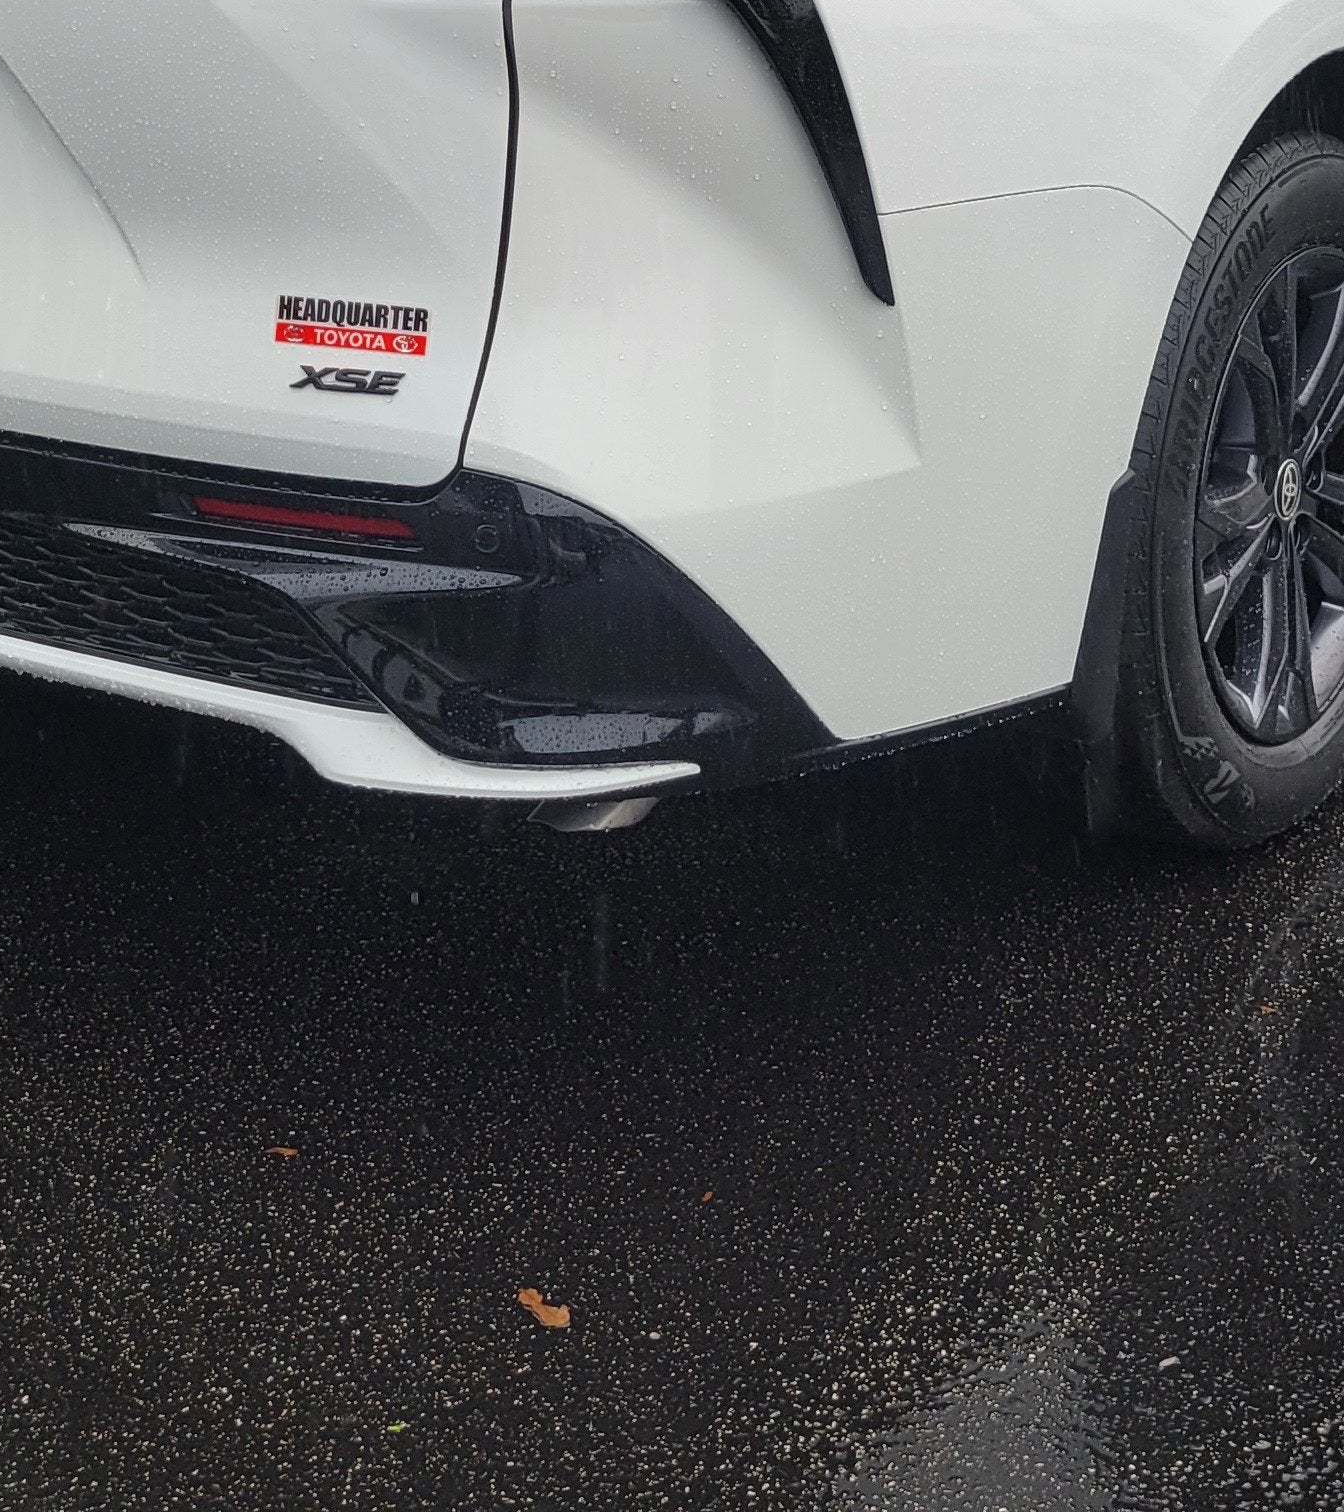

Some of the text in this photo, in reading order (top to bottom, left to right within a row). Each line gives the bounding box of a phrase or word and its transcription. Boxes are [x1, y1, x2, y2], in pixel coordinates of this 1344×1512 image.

[278, 294, 429, 333] HEADQUARTER
[313, 328, 386, 350] TOYOTA
[289, 364, 407, 396] XSE
